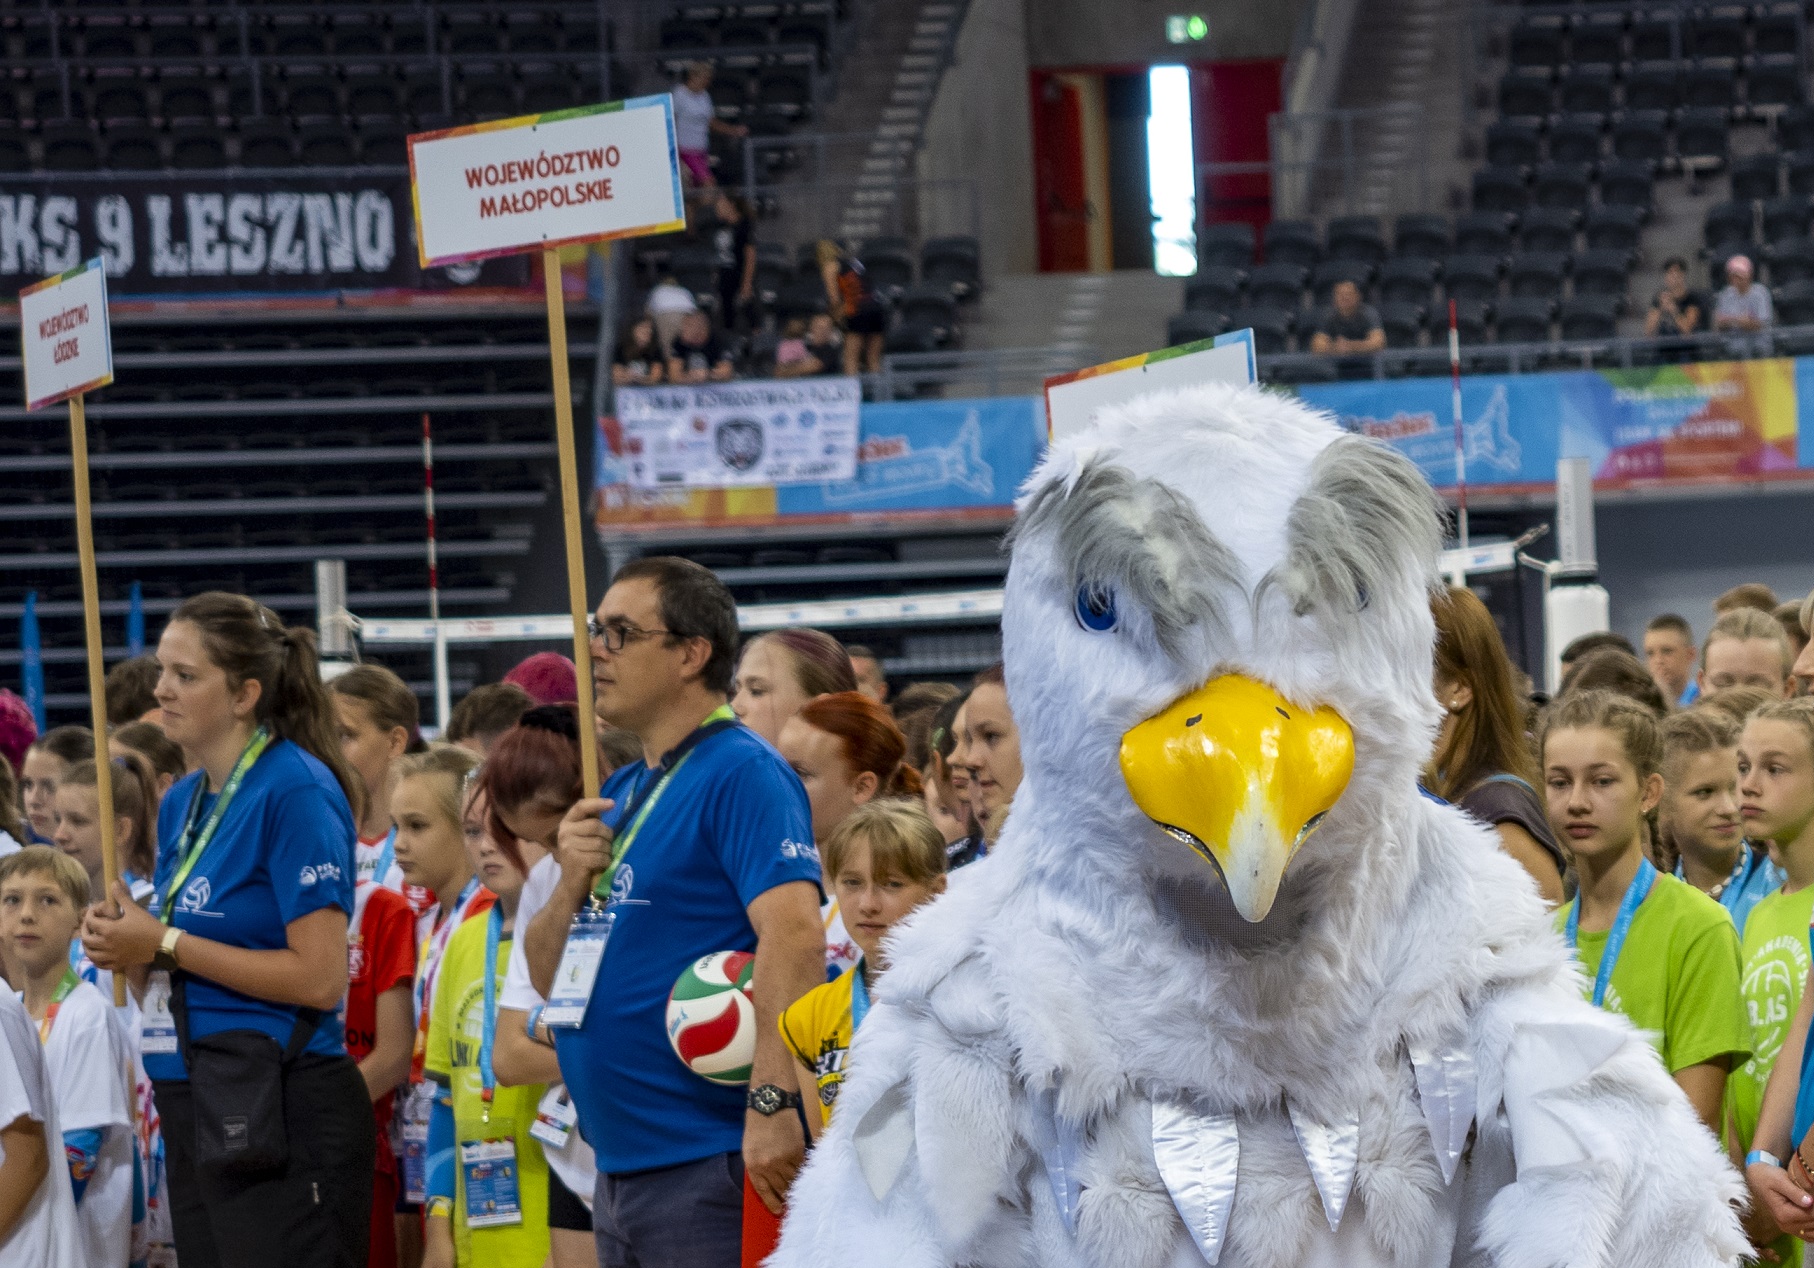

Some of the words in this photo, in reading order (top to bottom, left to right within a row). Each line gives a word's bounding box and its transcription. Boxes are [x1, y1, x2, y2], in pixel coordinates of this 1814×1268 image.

[465, 145, 621, 189] WOJEWÓDZTWO
[479, 178, 614, 219] MAŁOPOLSKIE
[95, 194, 135, 278] 9
[147, 189, 395, 278] LESZNO
[39, 303, 90, 342] WOJEWÓDZTWO
[53, 336, 80, 365] ŁÓDZKIE
